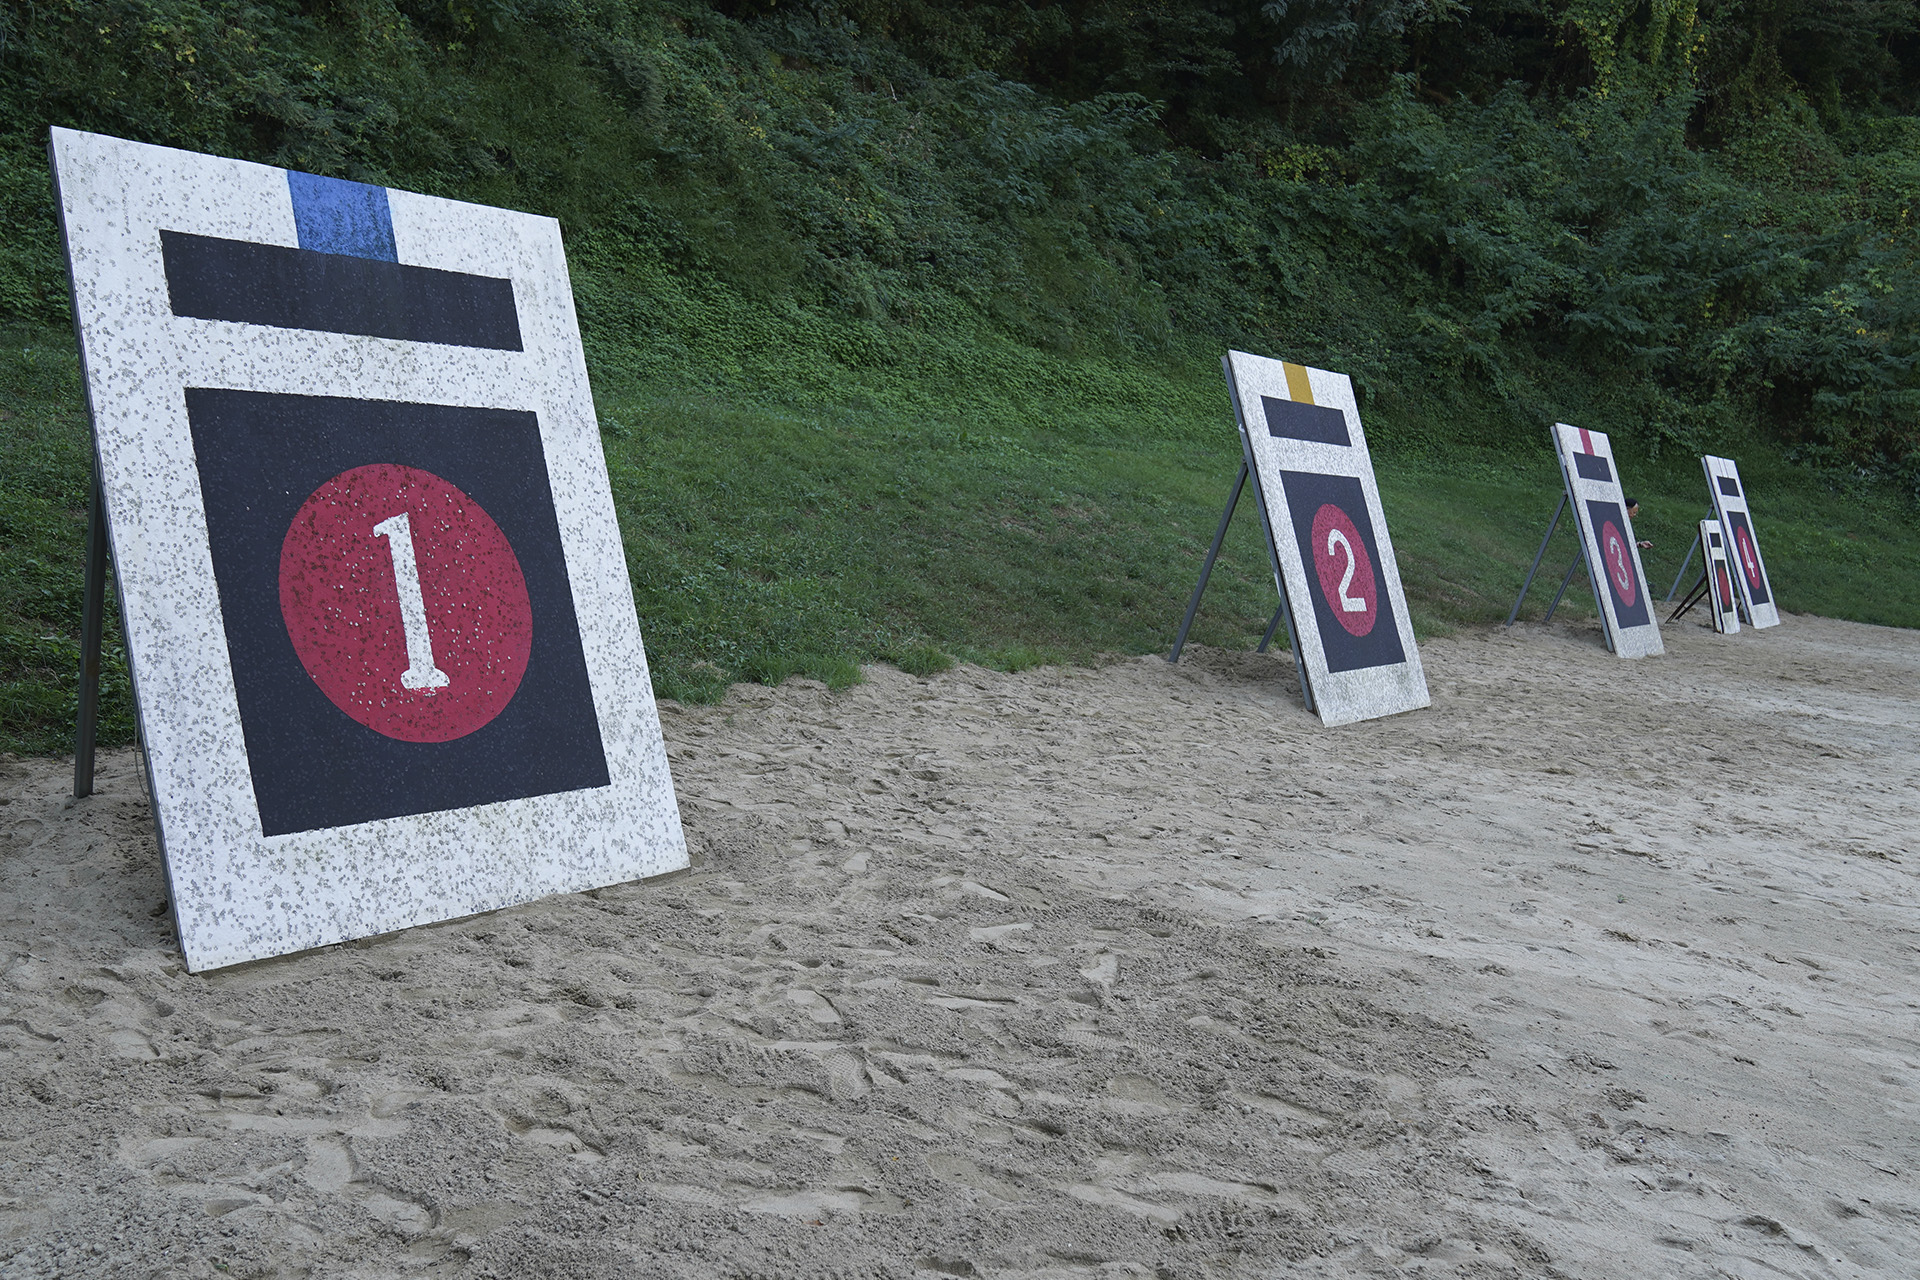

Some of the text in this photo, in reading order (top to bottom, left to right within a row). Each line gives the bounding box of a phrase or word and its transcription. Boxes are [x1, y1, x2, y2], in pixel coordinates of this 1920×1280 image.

[1327, 528, 1367, 612] 2
[1610, 536, 1629, 591] 3
[1741, 537, 1756, 578] 4
[373, 511, 449, 694] 1
